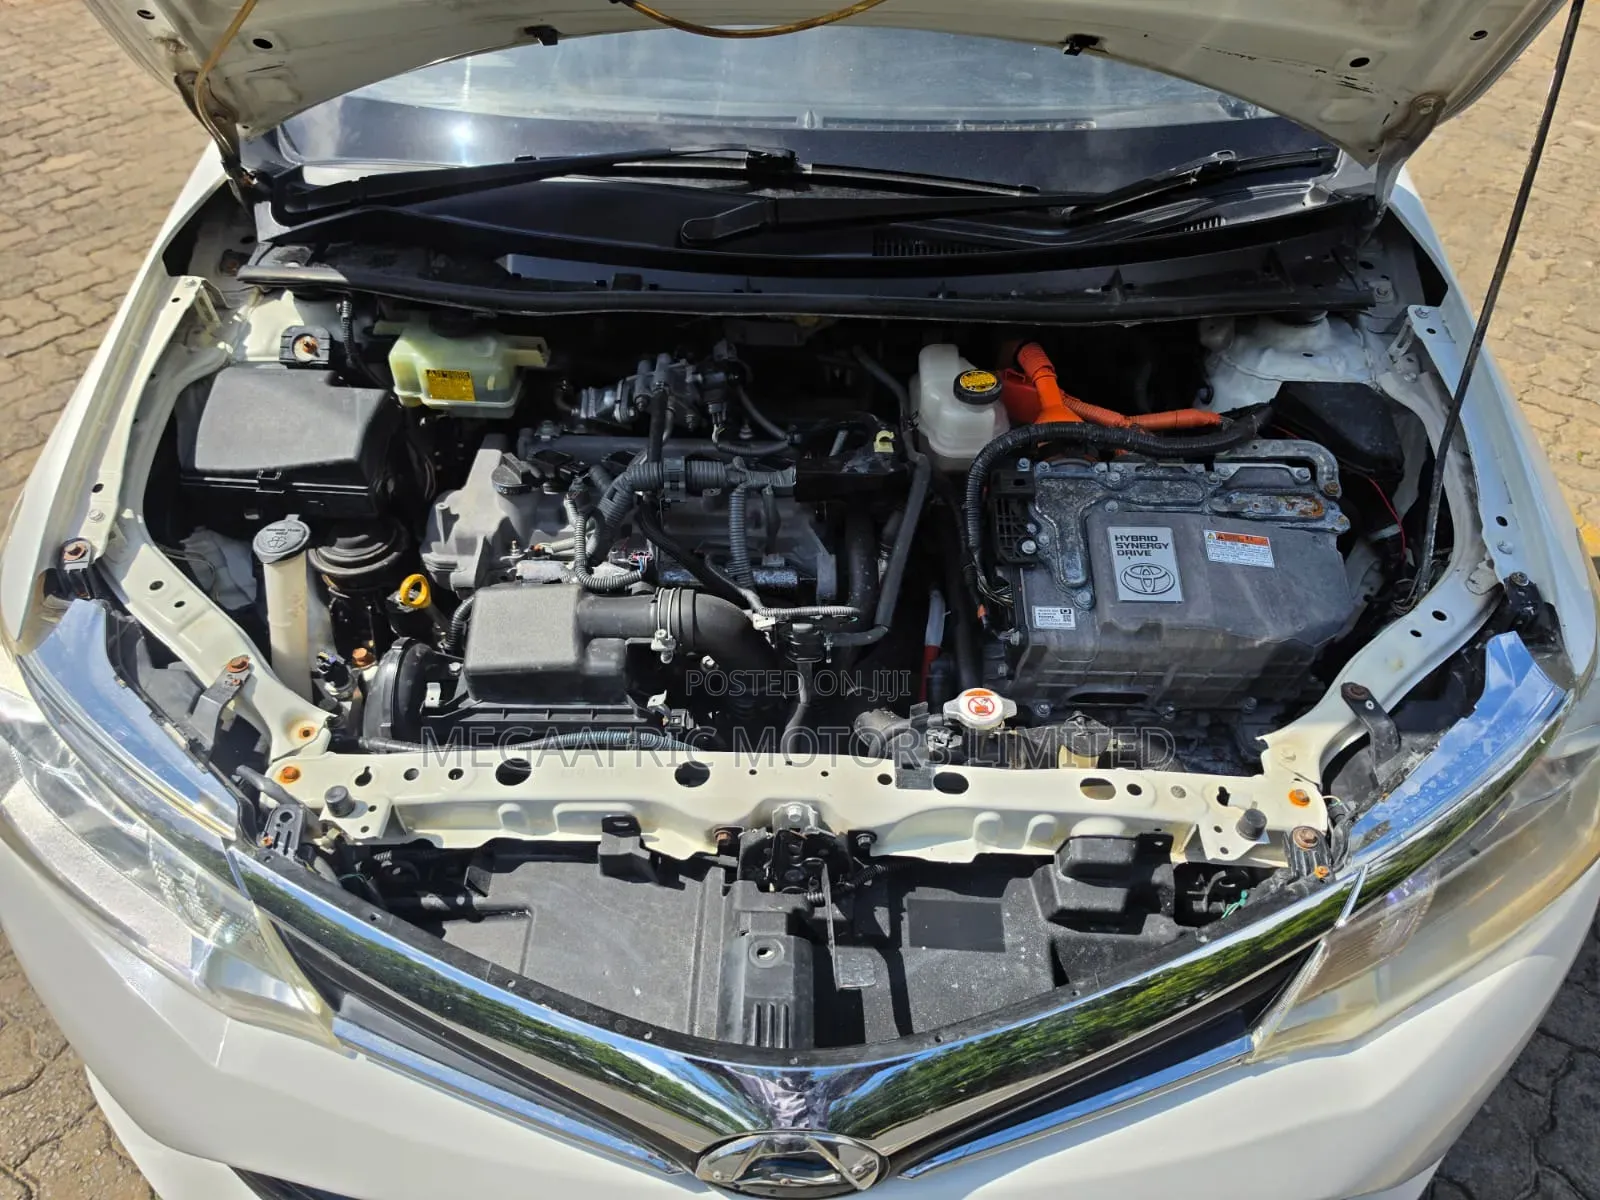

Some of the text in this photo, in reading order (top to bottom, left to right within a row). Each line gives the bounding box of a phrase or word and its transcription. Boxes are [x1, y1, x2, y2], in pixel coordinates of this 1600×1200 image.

[1114, 534, 1158, 542] HYBRID
[1115, 542, 1169, 550] SYNERGY
[1117, 549, 1152, 557] DRIVE
